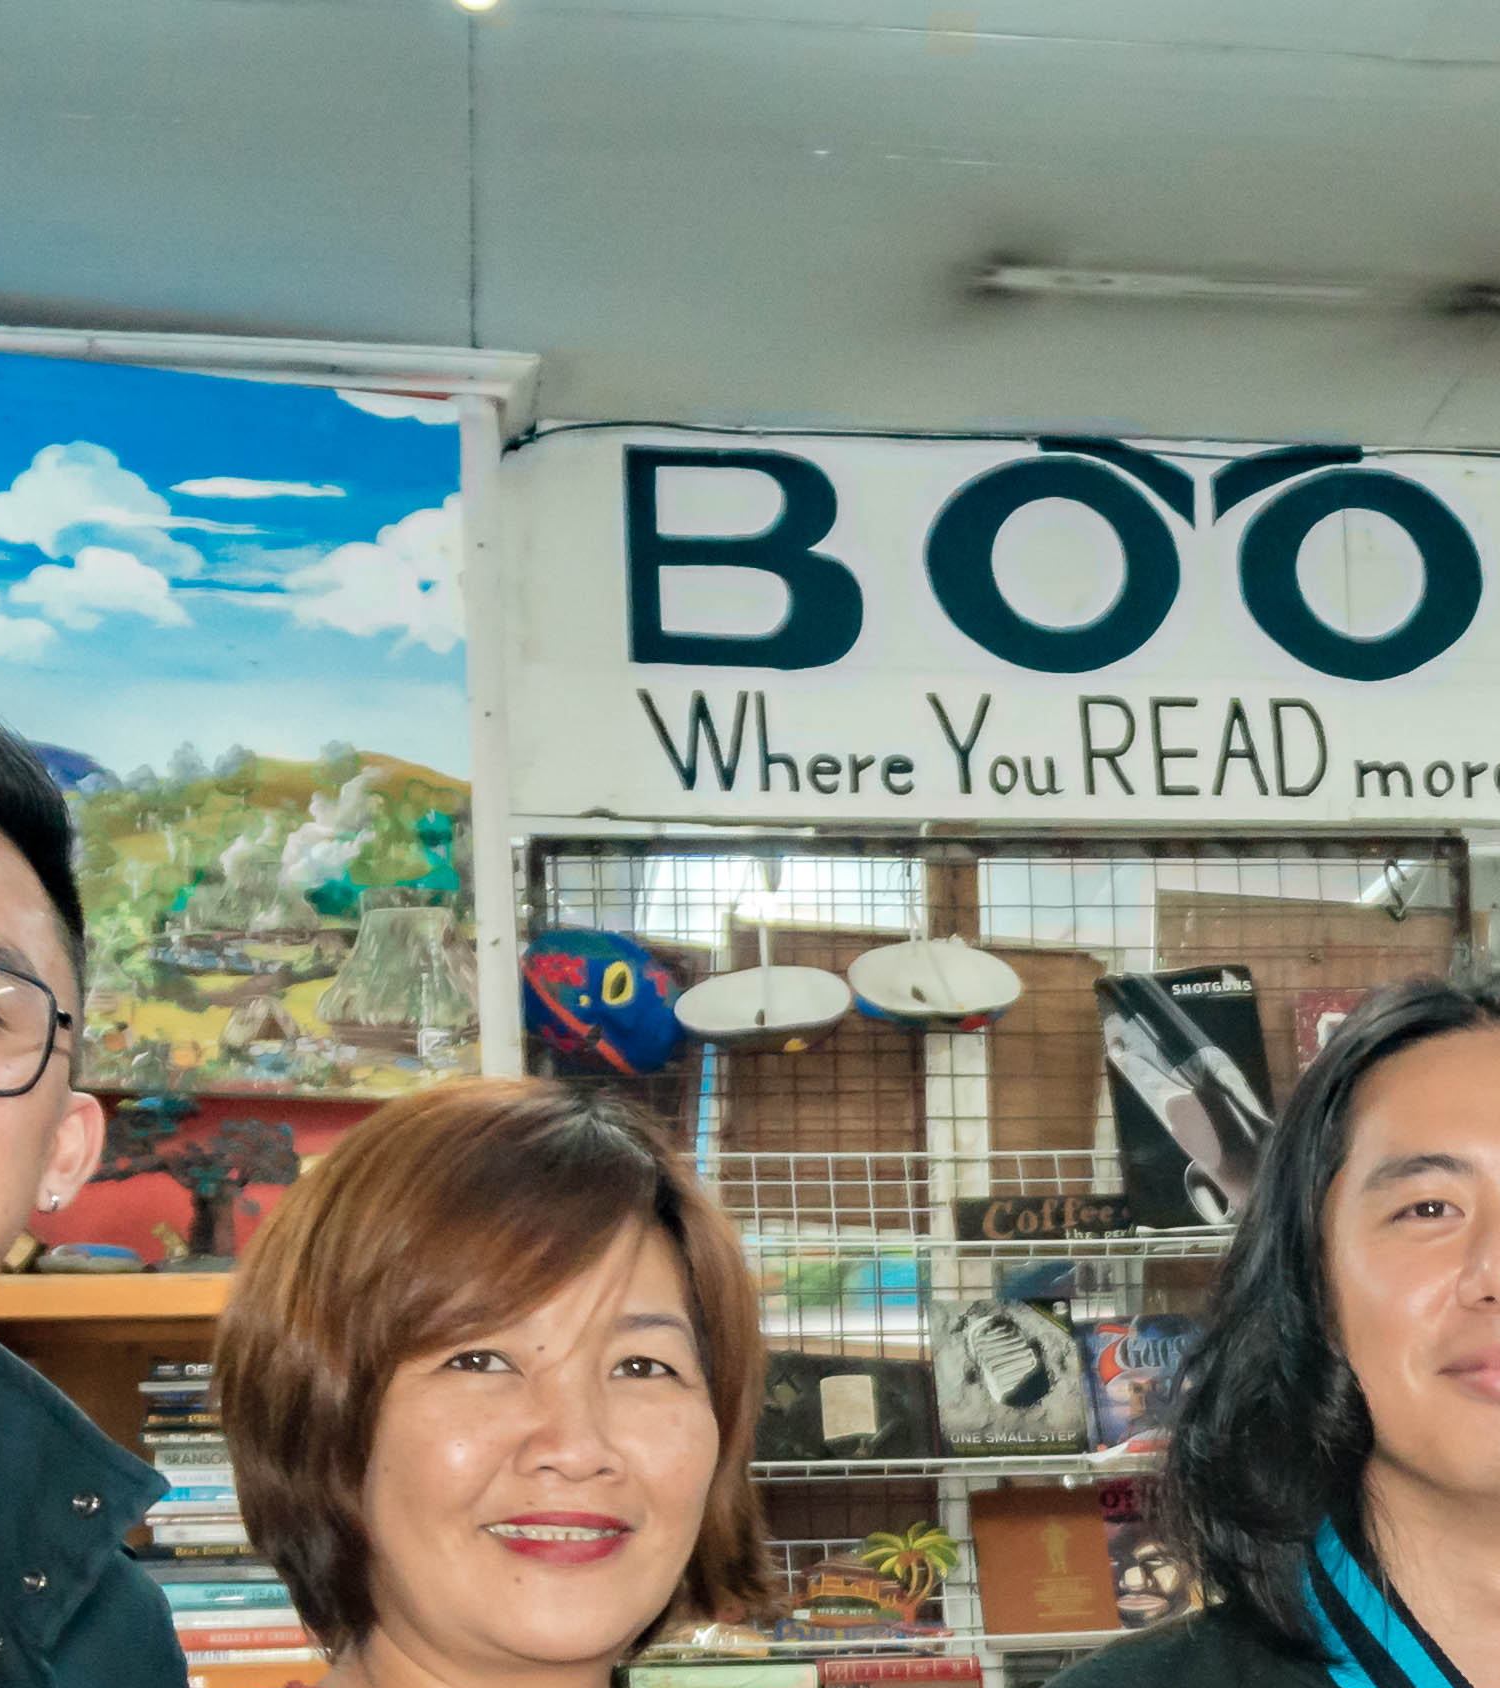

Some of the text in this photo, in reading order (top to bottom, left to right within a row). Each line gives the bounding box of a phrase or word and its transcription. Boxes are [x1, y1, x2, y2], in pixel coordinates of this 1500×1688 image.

[637, 688, 914, 795] Where
[927, 692, 1064, 796] You
[1078, 694, 1328, 798] READ
[1172, 979, 1253, 997] SHOTGUNS
[981, 1199, 1115, 1241] Coffee
[950, 1430, 1078, 1445] ONE SMALL STEP
